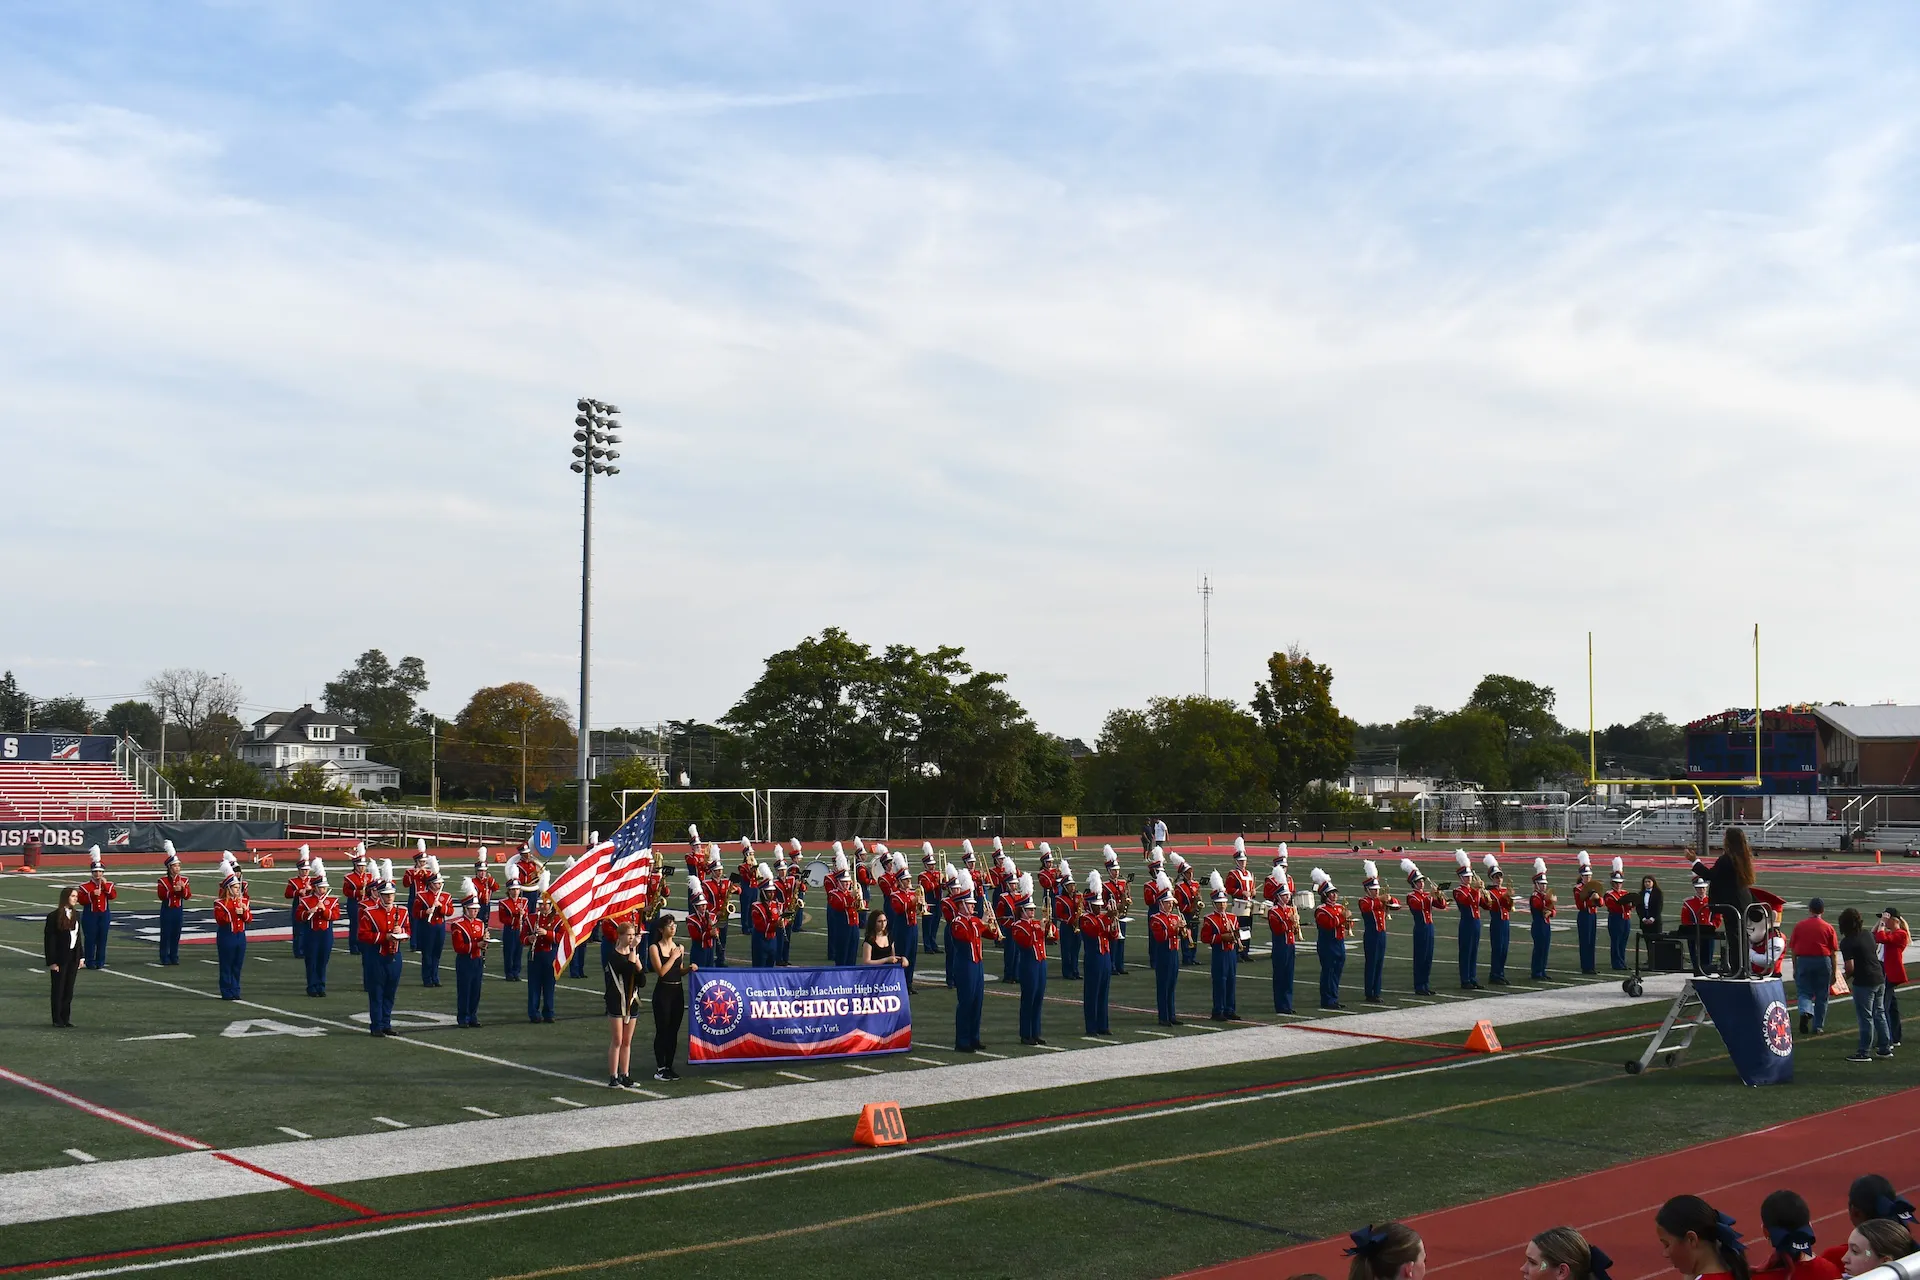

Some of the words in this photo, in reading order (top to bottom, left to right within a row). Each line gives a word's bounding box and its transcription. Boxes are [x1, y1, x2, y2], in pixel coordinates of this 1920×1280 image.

[540, 830, 551, 848] M
[746, 986, 778, 997] General
[779, 985, 809, 998] Douglas
[810, 984, 853, 996] MacArthur
[854, 984, 872, 996] High
[873, 982, 901, 993] School
[694, 1004, 703, 1024] MAC
[719, 979, 737, 993] HIGH
[733, 991, 743, 1024] SCHOOL
[713, 1002, 726, 1014] M
[750, 998, 850, 1019] MARCHING
[852, 995, 901, 1014] BAND
[702, 1023, 736, 1035] GENERALS
[805, 1025, 822, 1034] New
[823, 1023, 840, 1033] York
[1481, 1024, 1501, 1048] 50
[873, 1107, 905, 1141] 40
